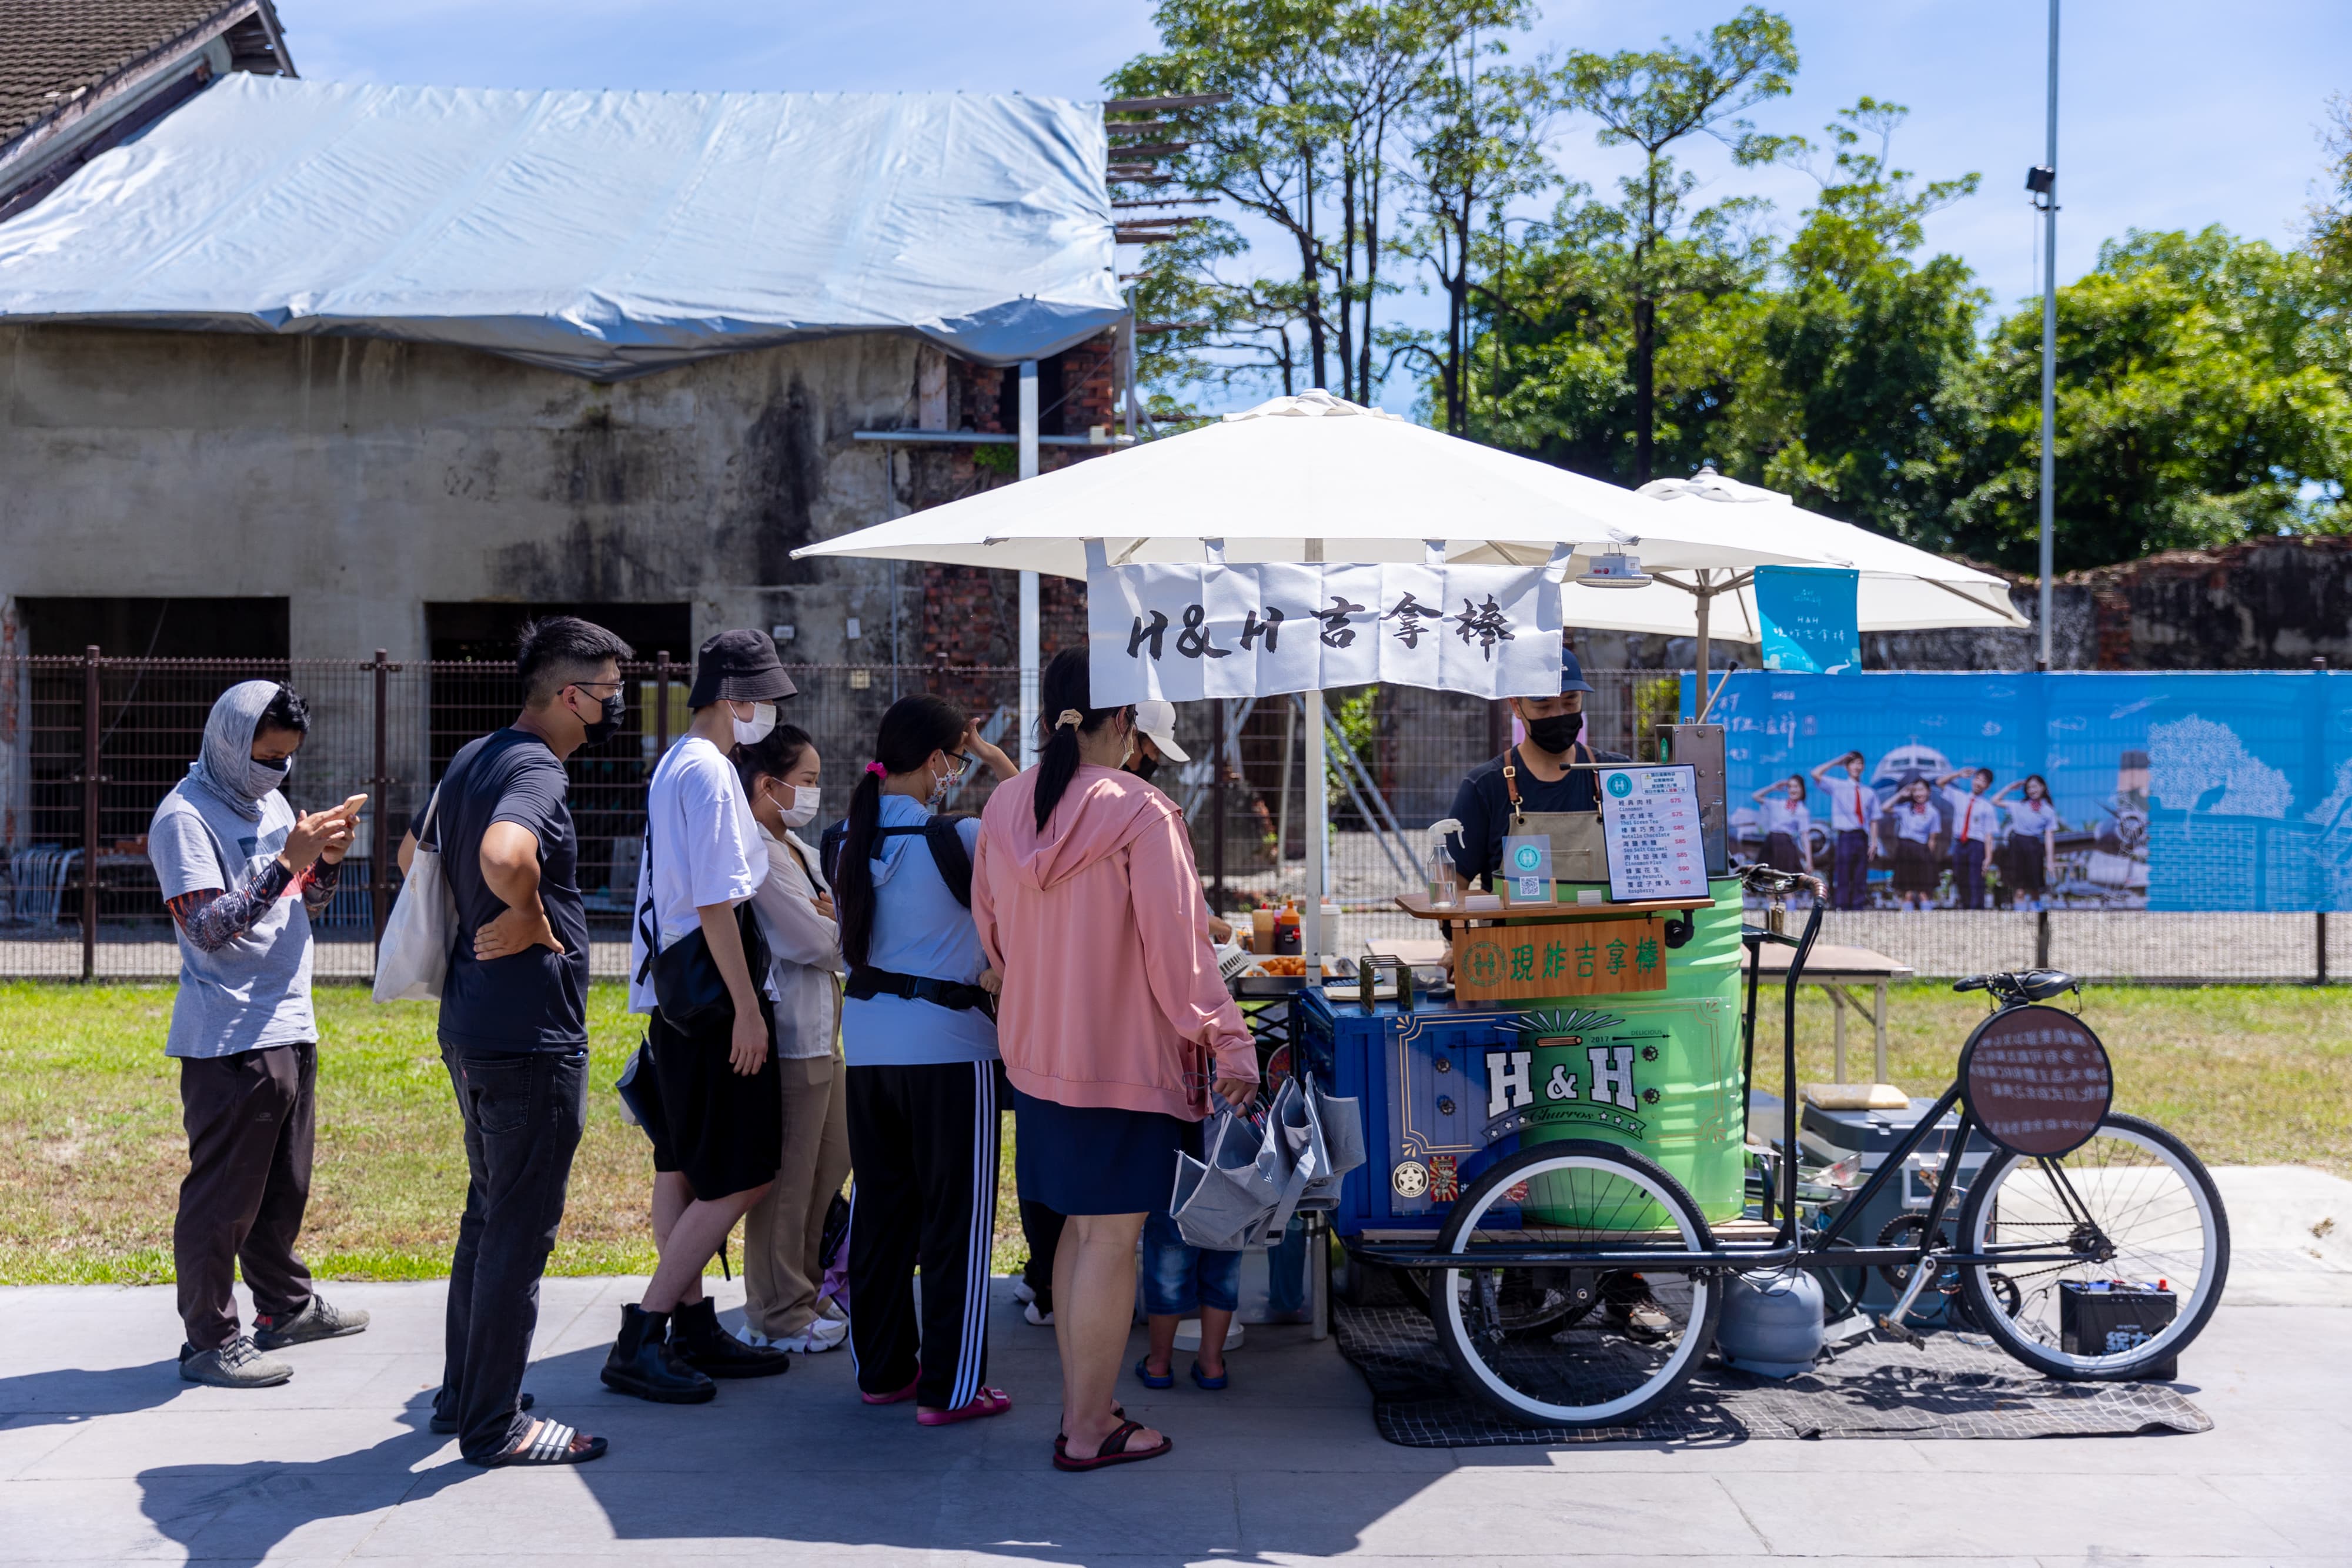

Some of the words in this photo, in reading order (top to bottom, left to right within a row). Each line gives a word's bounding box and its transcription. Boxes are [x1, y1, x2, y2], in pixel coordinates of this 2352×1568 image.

[1309, 591, 1515, 663] 吉拿棒
[1510, 935, 1659, 981] 現炸吉拿棒
[1530, 1107, 1594, 1124] Churros
